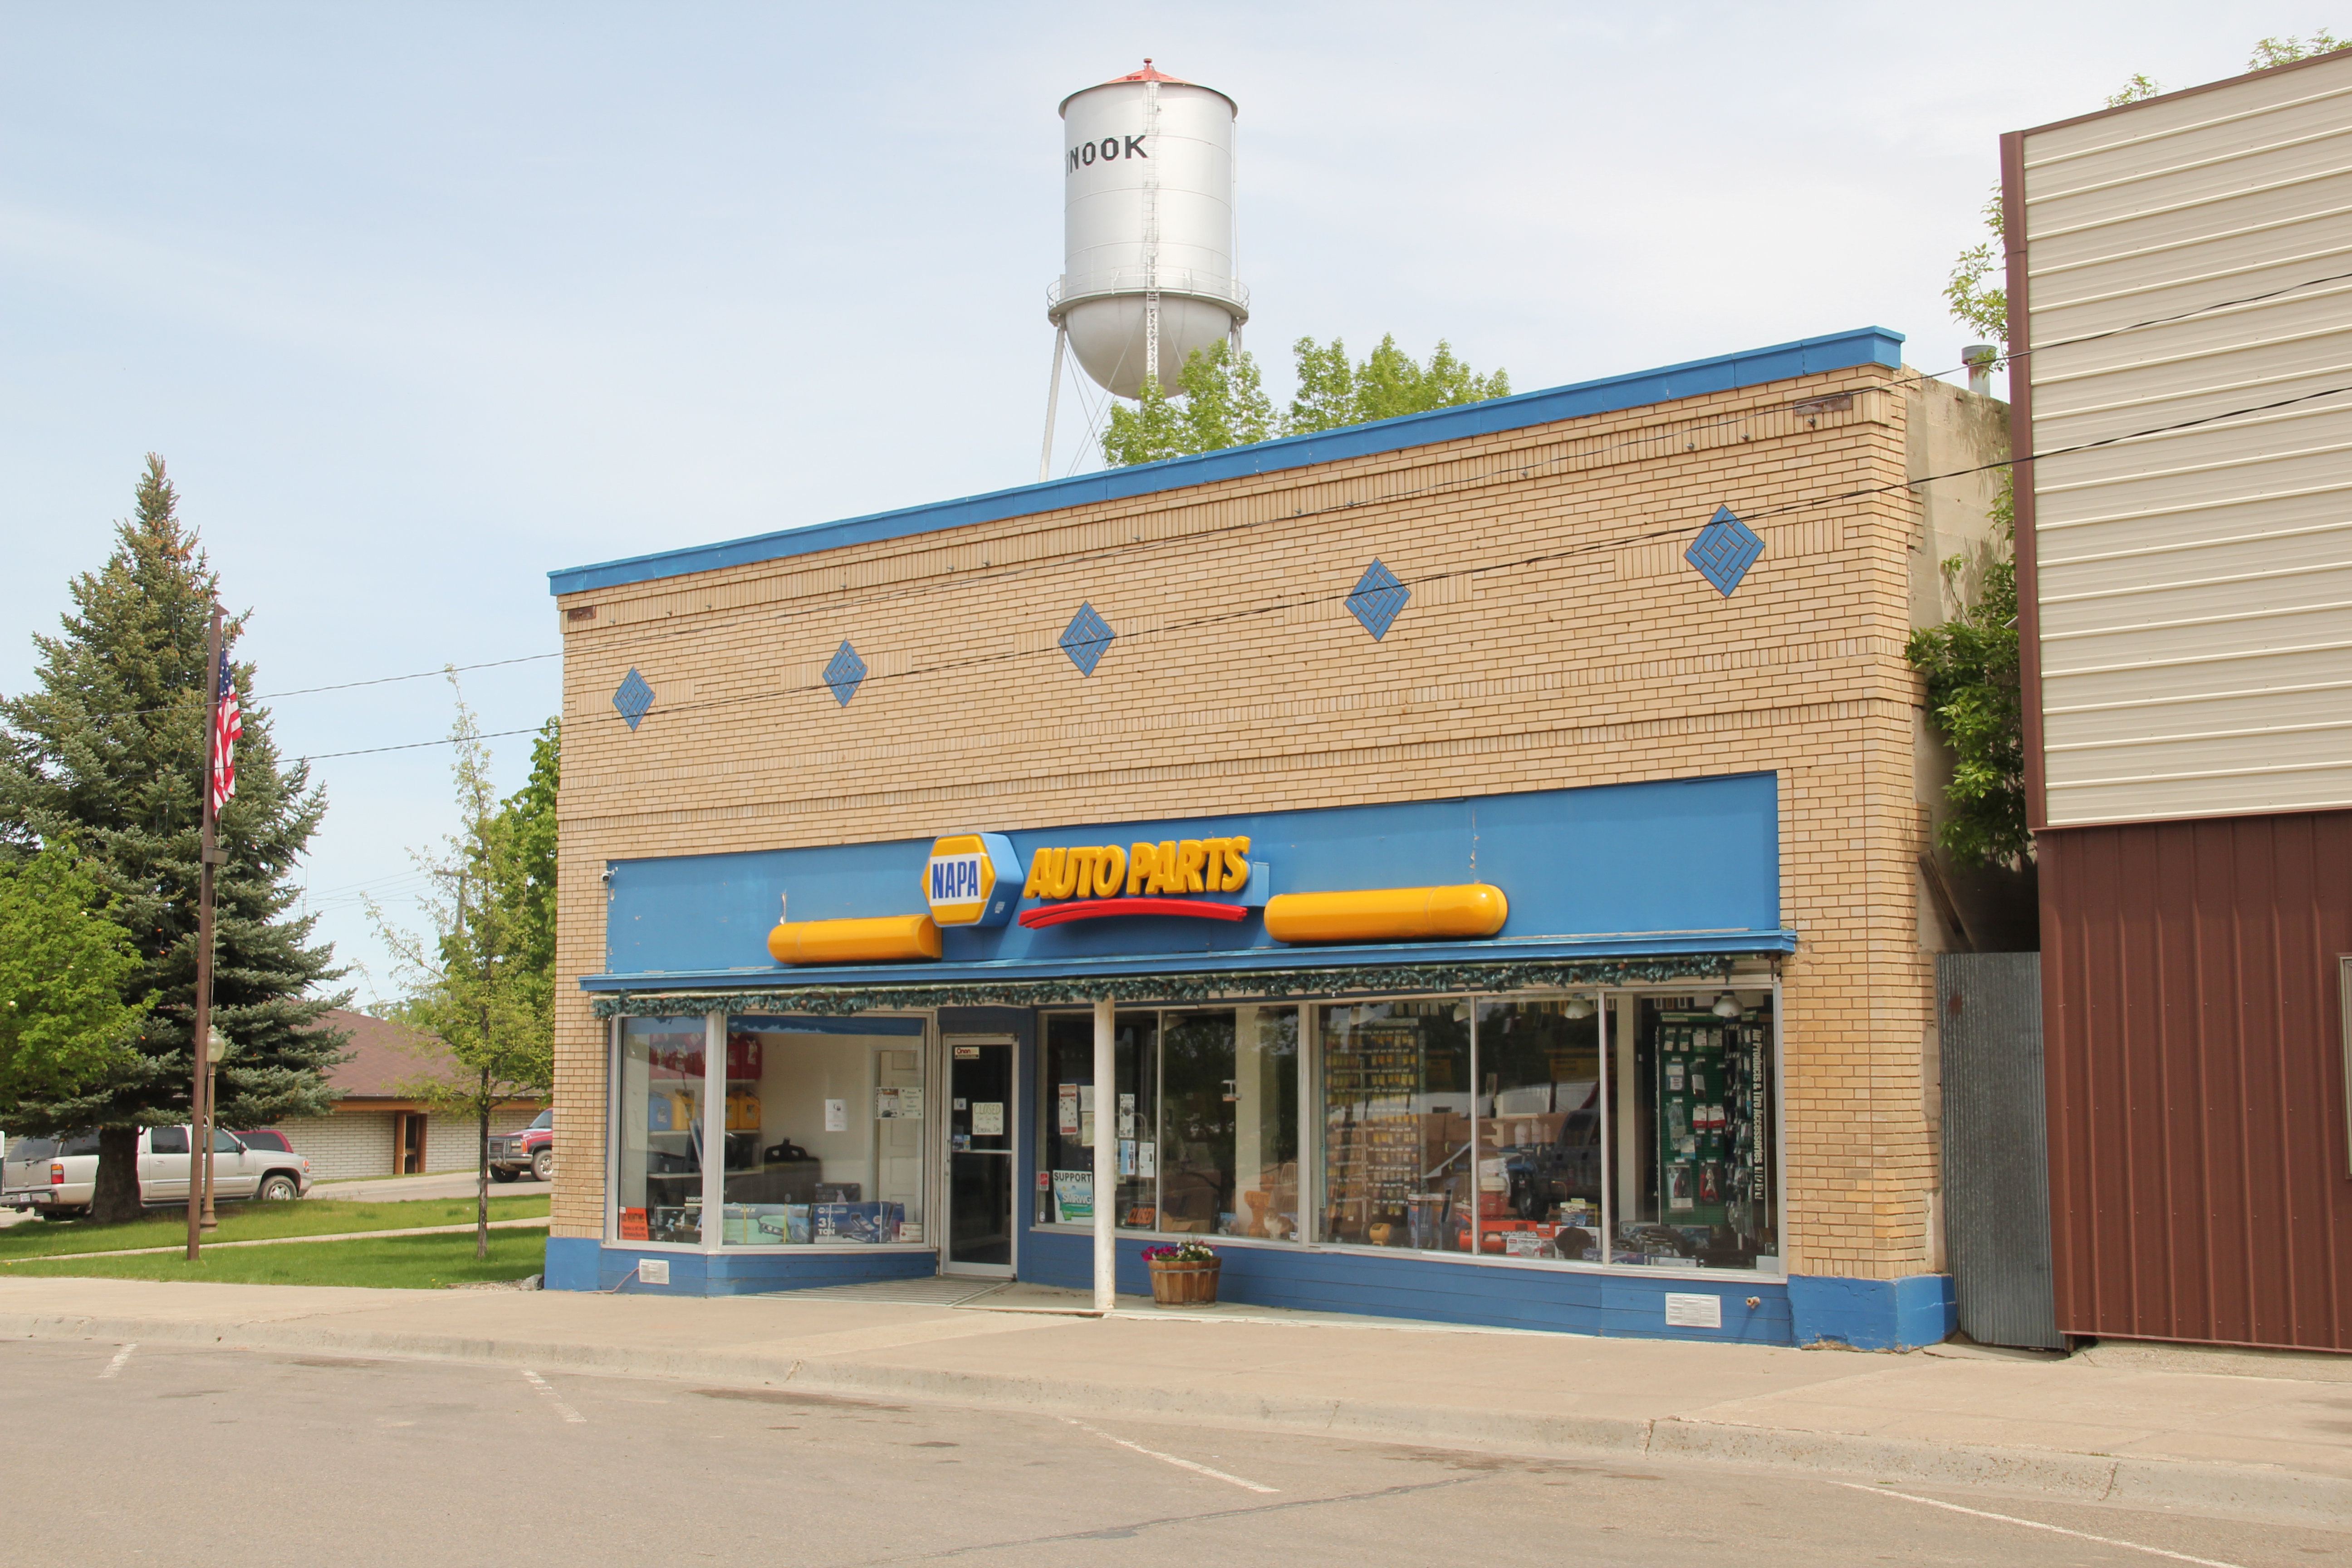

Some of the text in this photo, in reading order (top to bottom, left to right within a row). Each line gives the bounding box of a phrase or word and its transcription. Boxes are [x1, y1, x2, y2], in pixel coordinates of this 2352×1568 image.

[1022, 835, 1251, 900] AUTO PARTS
[932, 860, 978, 899] NAPA
[1753, 1029, 1762, 1042] Air
[1753, 1043, 1763, 1082] Products
[1753, 1091, 1763, 1108] Tire
[974, 1103, 1001, 1115] CLOSED
[1753, 1109, 1764, 1163] Accessories
[1054, 1172, 1092, 1182] SUPPORT
[1062, 1194, 1092, 1204] SMRWG
[1127, 1207, 1156, 1224] CLOSED
